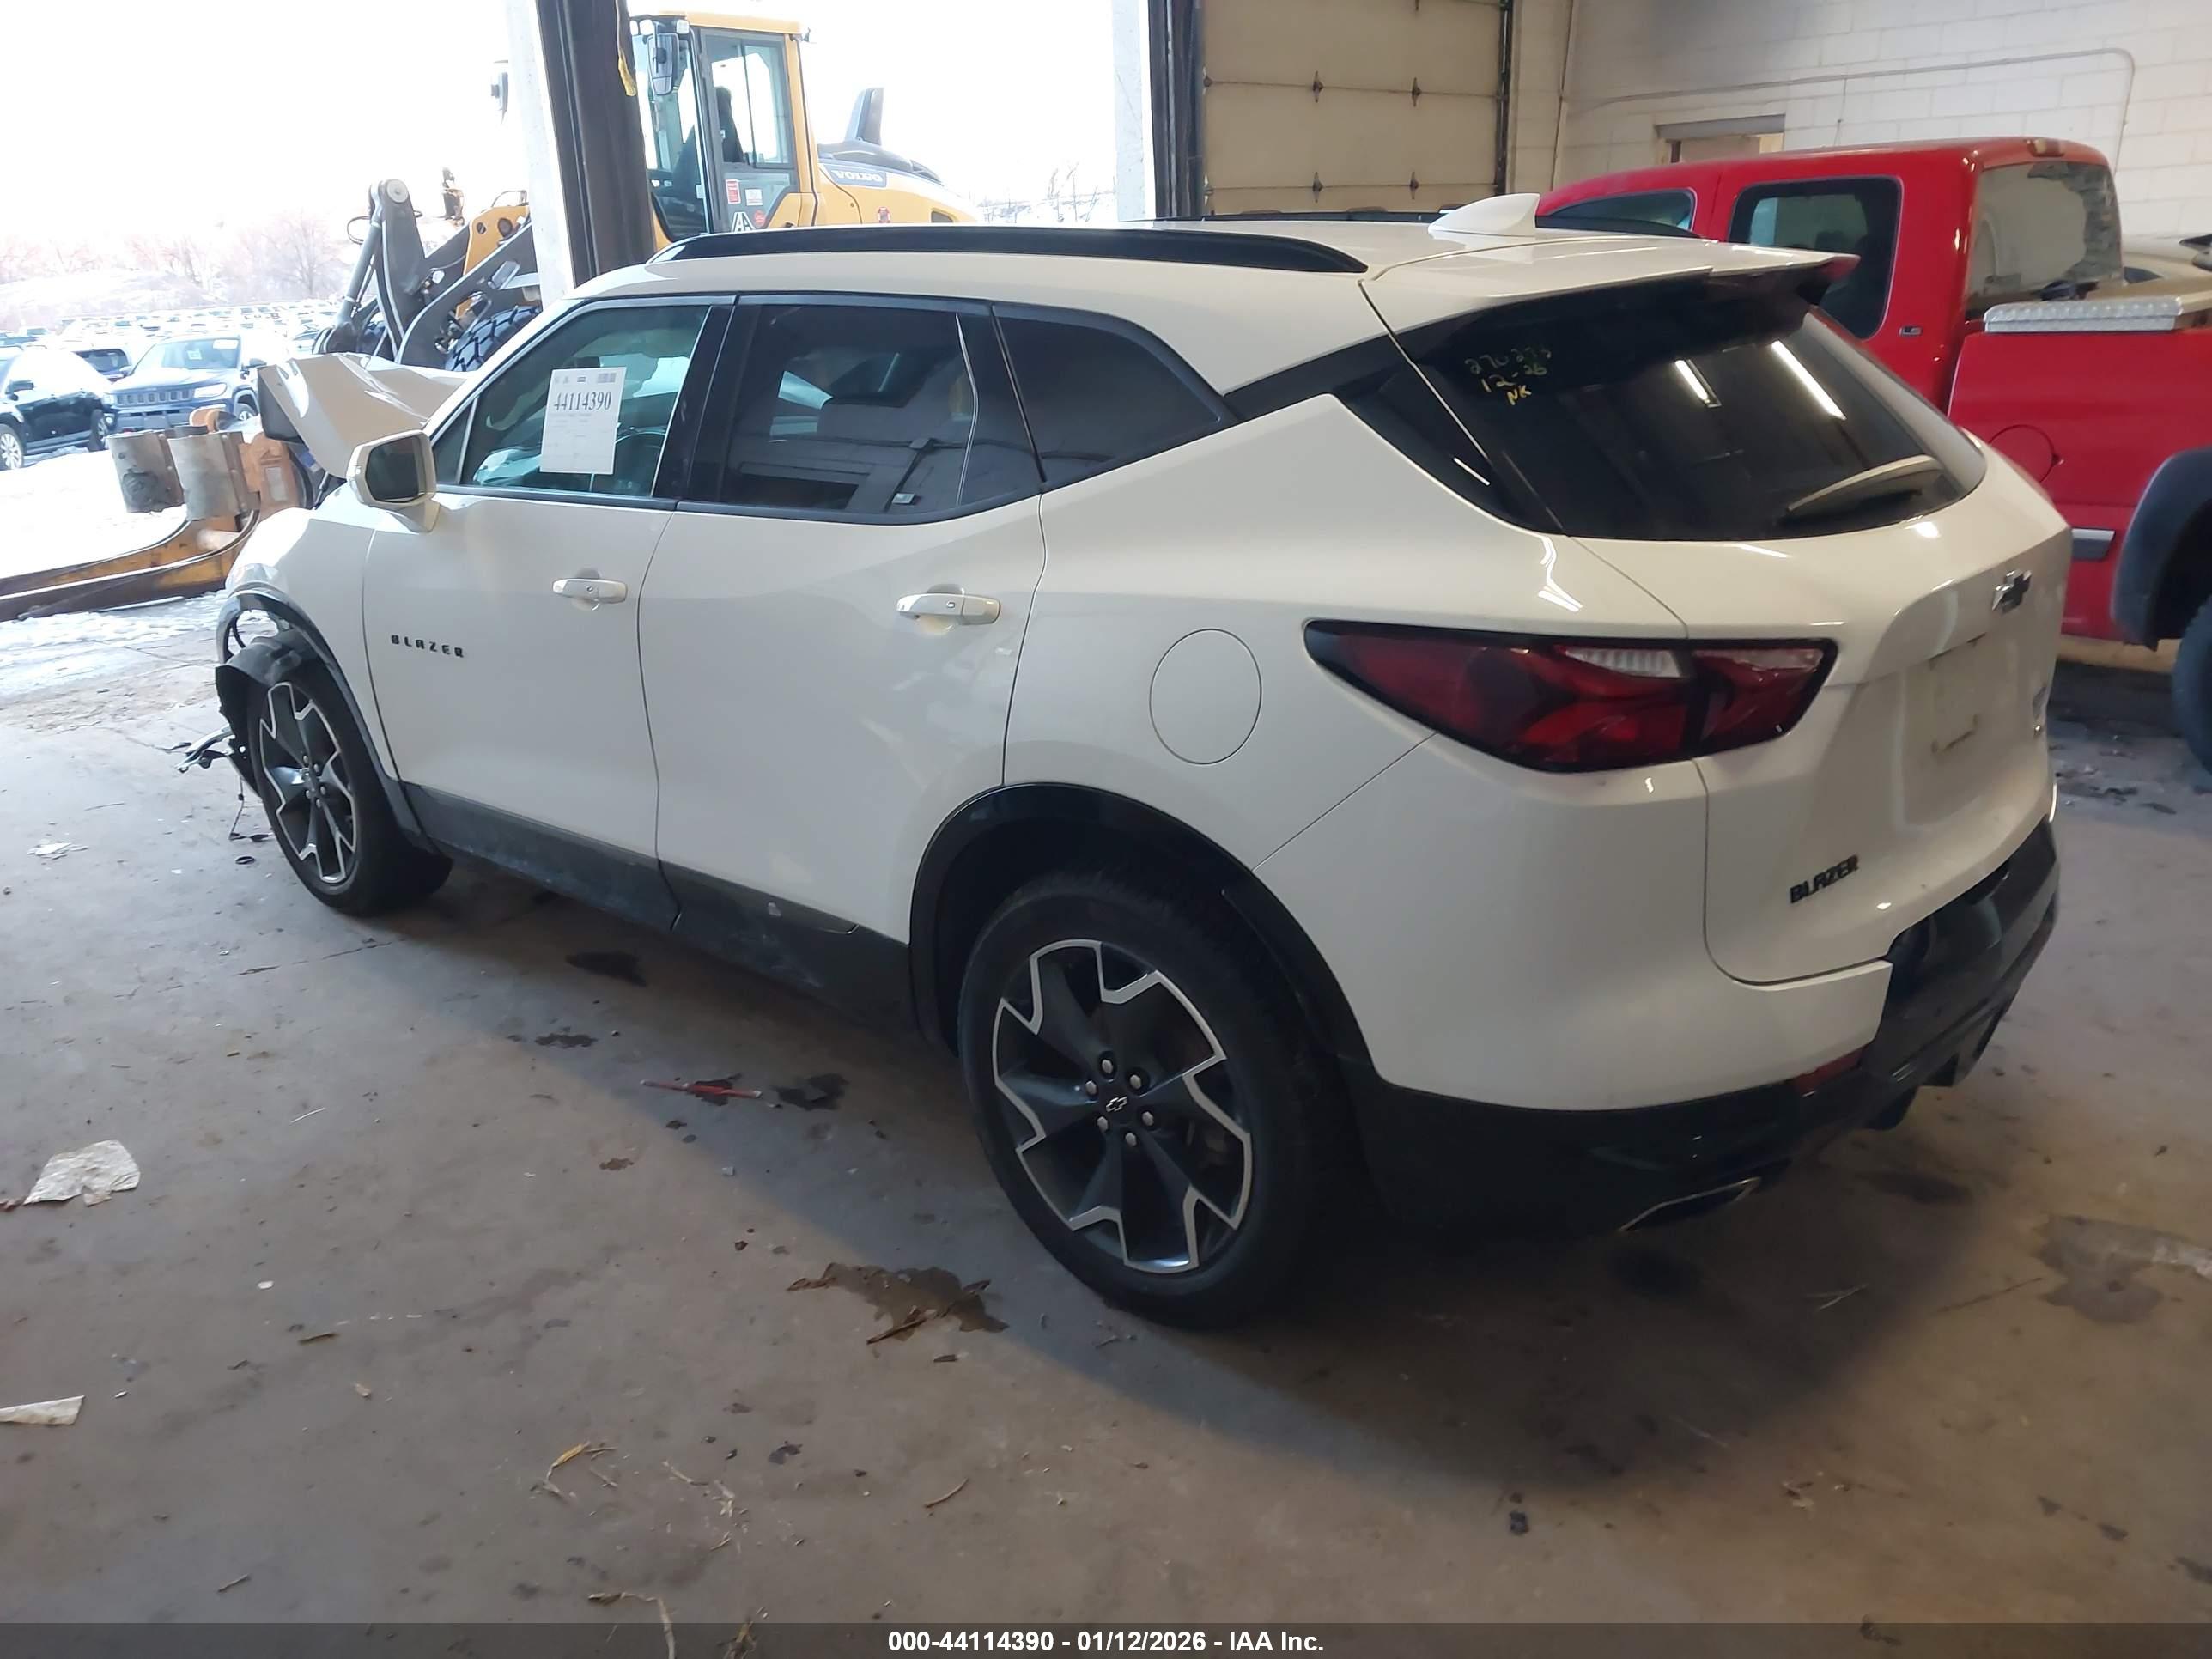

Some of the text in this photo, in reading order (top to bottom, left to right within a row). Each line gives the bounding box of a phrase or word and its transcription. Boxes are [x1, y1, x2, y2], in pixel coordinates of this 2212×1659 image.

[830, 170, 884, 182] VOLVO
[554, 390, 612, 411] 44114390
[391, 634, 465, 659] BLAZER
[1790, 854, 1859, 903] BLAZER
